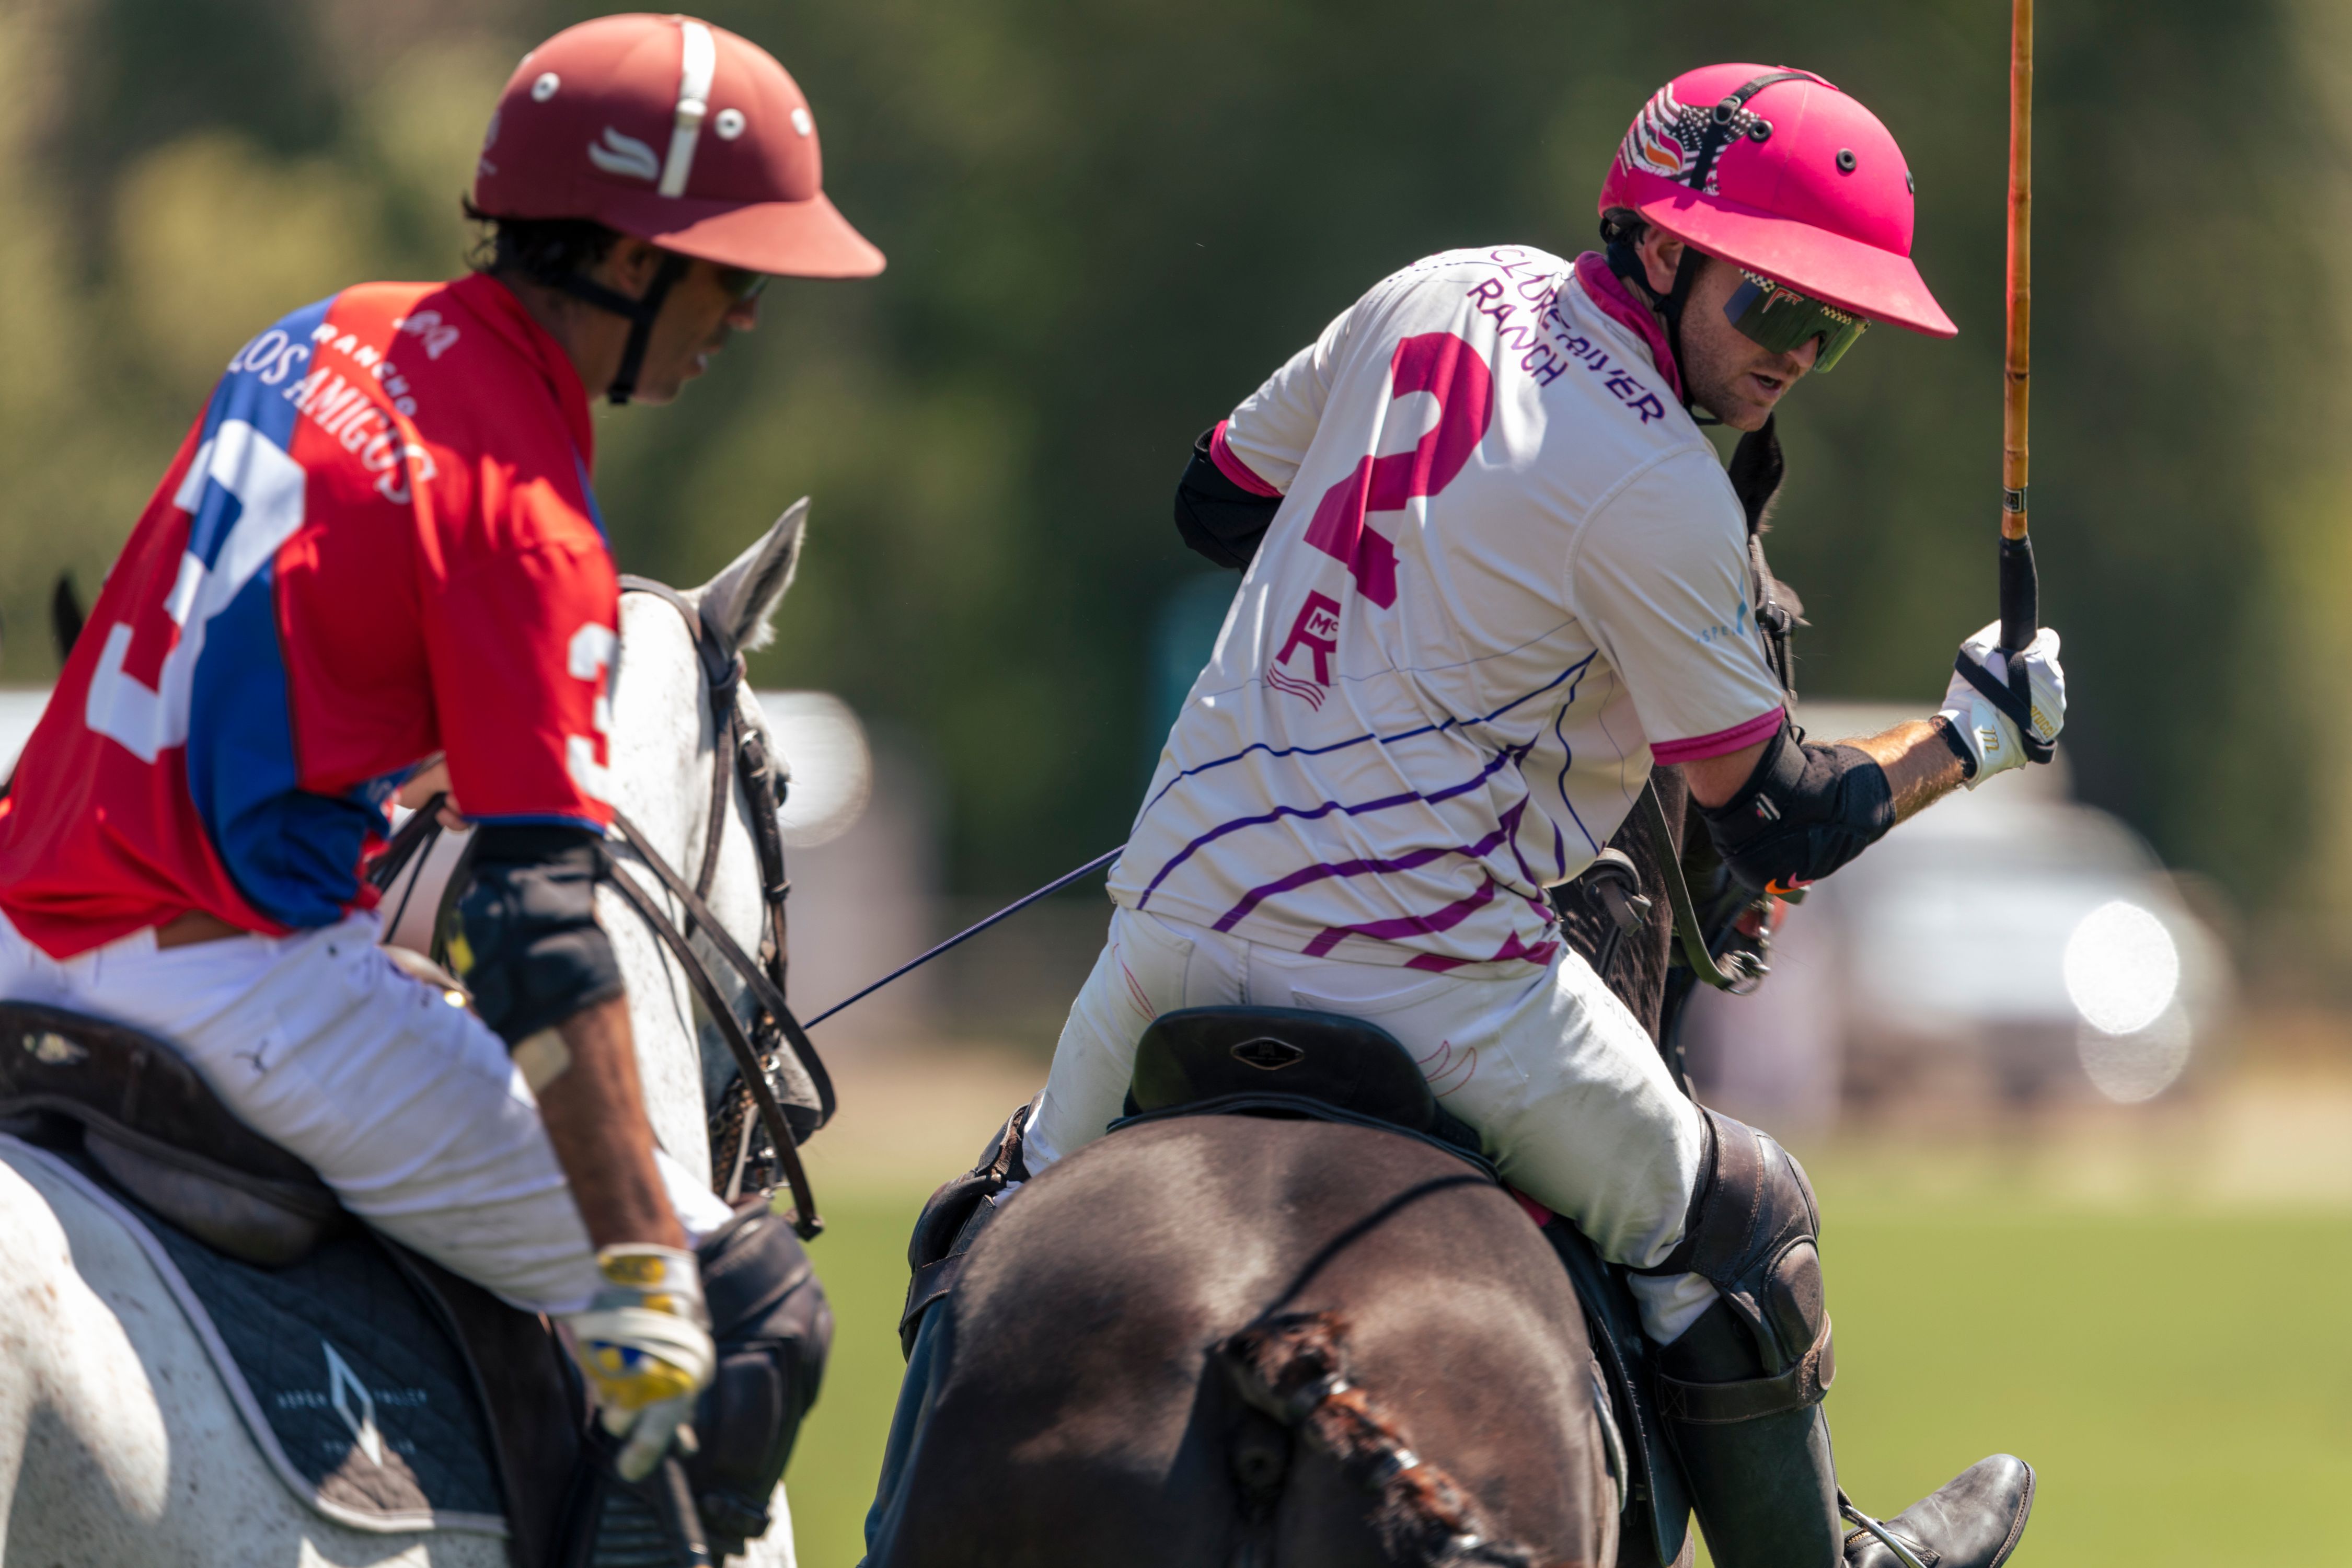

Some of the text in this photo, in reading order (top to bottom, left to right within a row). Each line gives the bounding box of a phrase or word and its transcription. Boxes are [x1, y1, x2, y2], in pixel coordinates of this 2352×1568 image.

[311, 322, 417, 418] RANCHO
[1466, 278, 1568, 388] RANCH
[1555, 333, 1665, 424] RIVER
[227, 329, 309, 385] LOS
[281, 365, 438, 505] AMIGOS
[1303, 332, 1494, 610] 2
[85, 418, 308, 765] 3
[1695, 626, 1737, 643] SPE
[566, 620, 620, 806] 3
[2031, 705, 2058, 739] arucci
